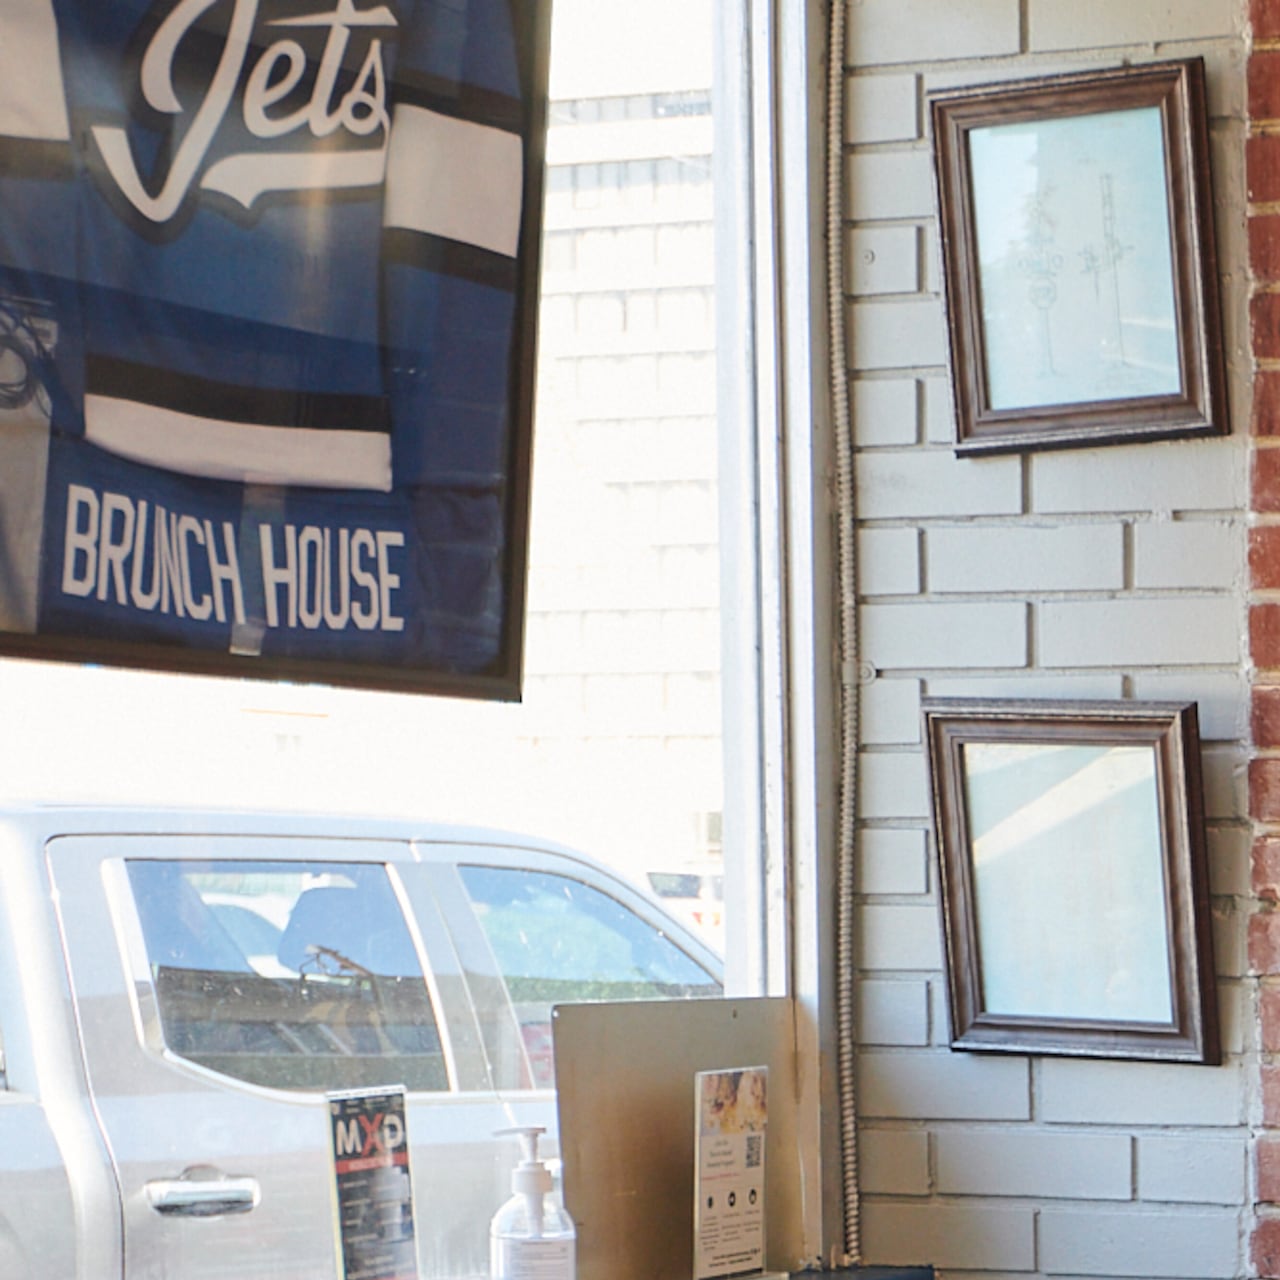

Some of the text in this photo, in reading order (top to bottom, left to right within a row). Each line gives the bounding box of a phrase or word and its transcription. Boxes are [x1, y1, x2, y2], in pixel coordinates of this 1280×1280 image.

[91, 0, 398, 222] Jets
[62, 483, 405, 631] BRUNCH HOUSE
